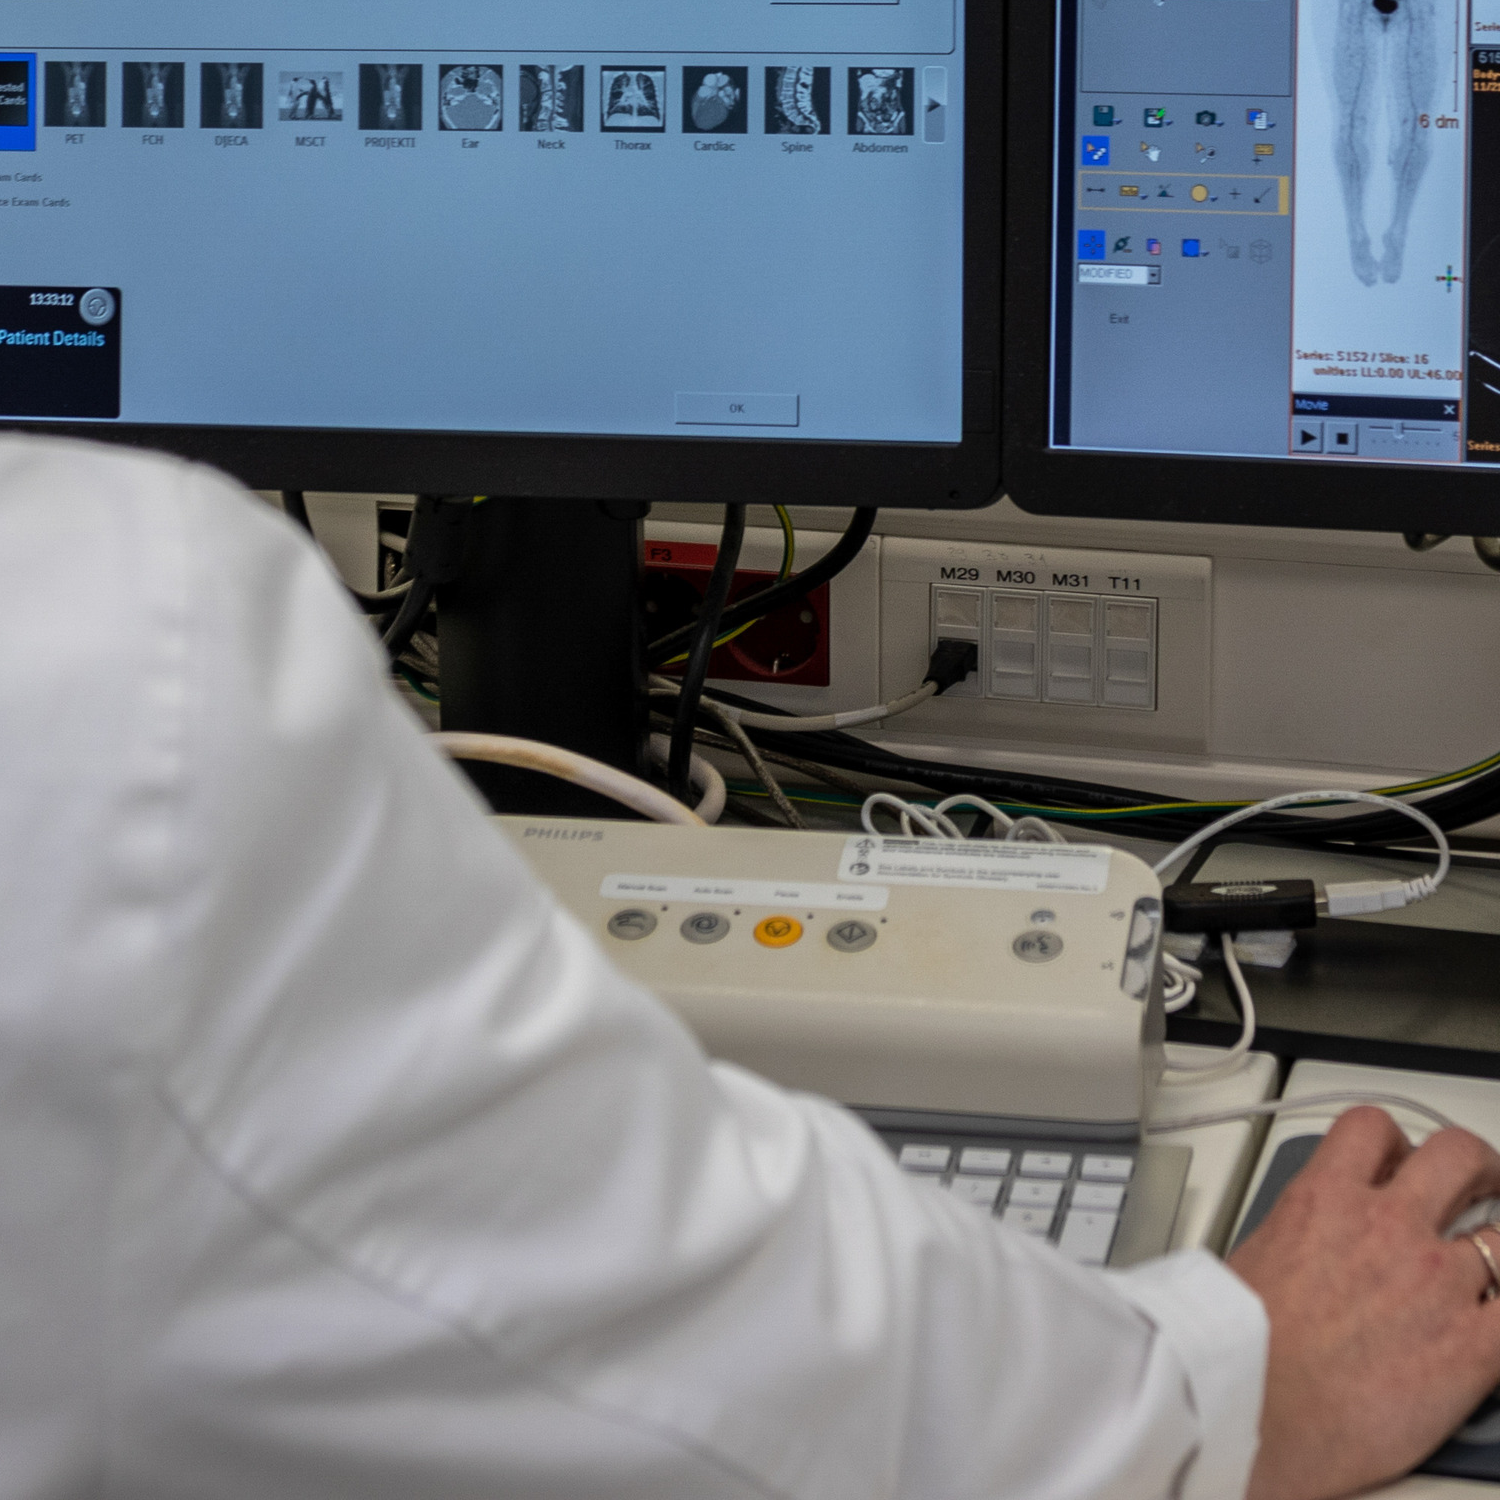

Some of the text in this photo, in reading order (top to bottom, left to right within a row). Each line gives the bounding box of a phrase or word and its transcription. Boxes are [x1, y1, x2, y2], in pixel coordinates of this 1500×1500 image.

[1419, 115, 1459, 129] 6 dm
[65, 134, 85, 145] PET
[141, 134, 164, 146] FCH
[215, 135, 249, 148] DJECA
[295, 136, 326, 147] MSCT
[364, 137, 416, 150] PROJEKTI
[461, 138, 480, 149] Ear
[537, 138, 565, 150] Neck
[614, 139, 651, 151] Thorax
[693, 140, 736, 151] Cardiac
[781, 141, 814, 154] Spine
[853, 142, 908, 154] Abdomen
[14, 172, 43, 183] Cards
[11, 197, 39, 208] Exam
[42, 197, 70, 208] Cards
[1080, 267, 1133, 280] MODIFIED
[1109, 313, 1130, 324] Exit
[53, 330, 106, 347] Details
[1295, 350, 1334, 361] Series:
[1337, 351, 1369, 362] 5152
[1379, 352, 1410, 364] Slice:
[1414, 354, 1429, 365] 16
[1361, 367, 1404, 379] LL:0.00
[729, 403, 745, 414] OK
[1295, 400, 1329, 411] Movie
[651, 548, 673, 562] F3
[940, 566, 1141, 591] M29 M30 M31 T11
[523, 827, 604, 842] PHILIPS
